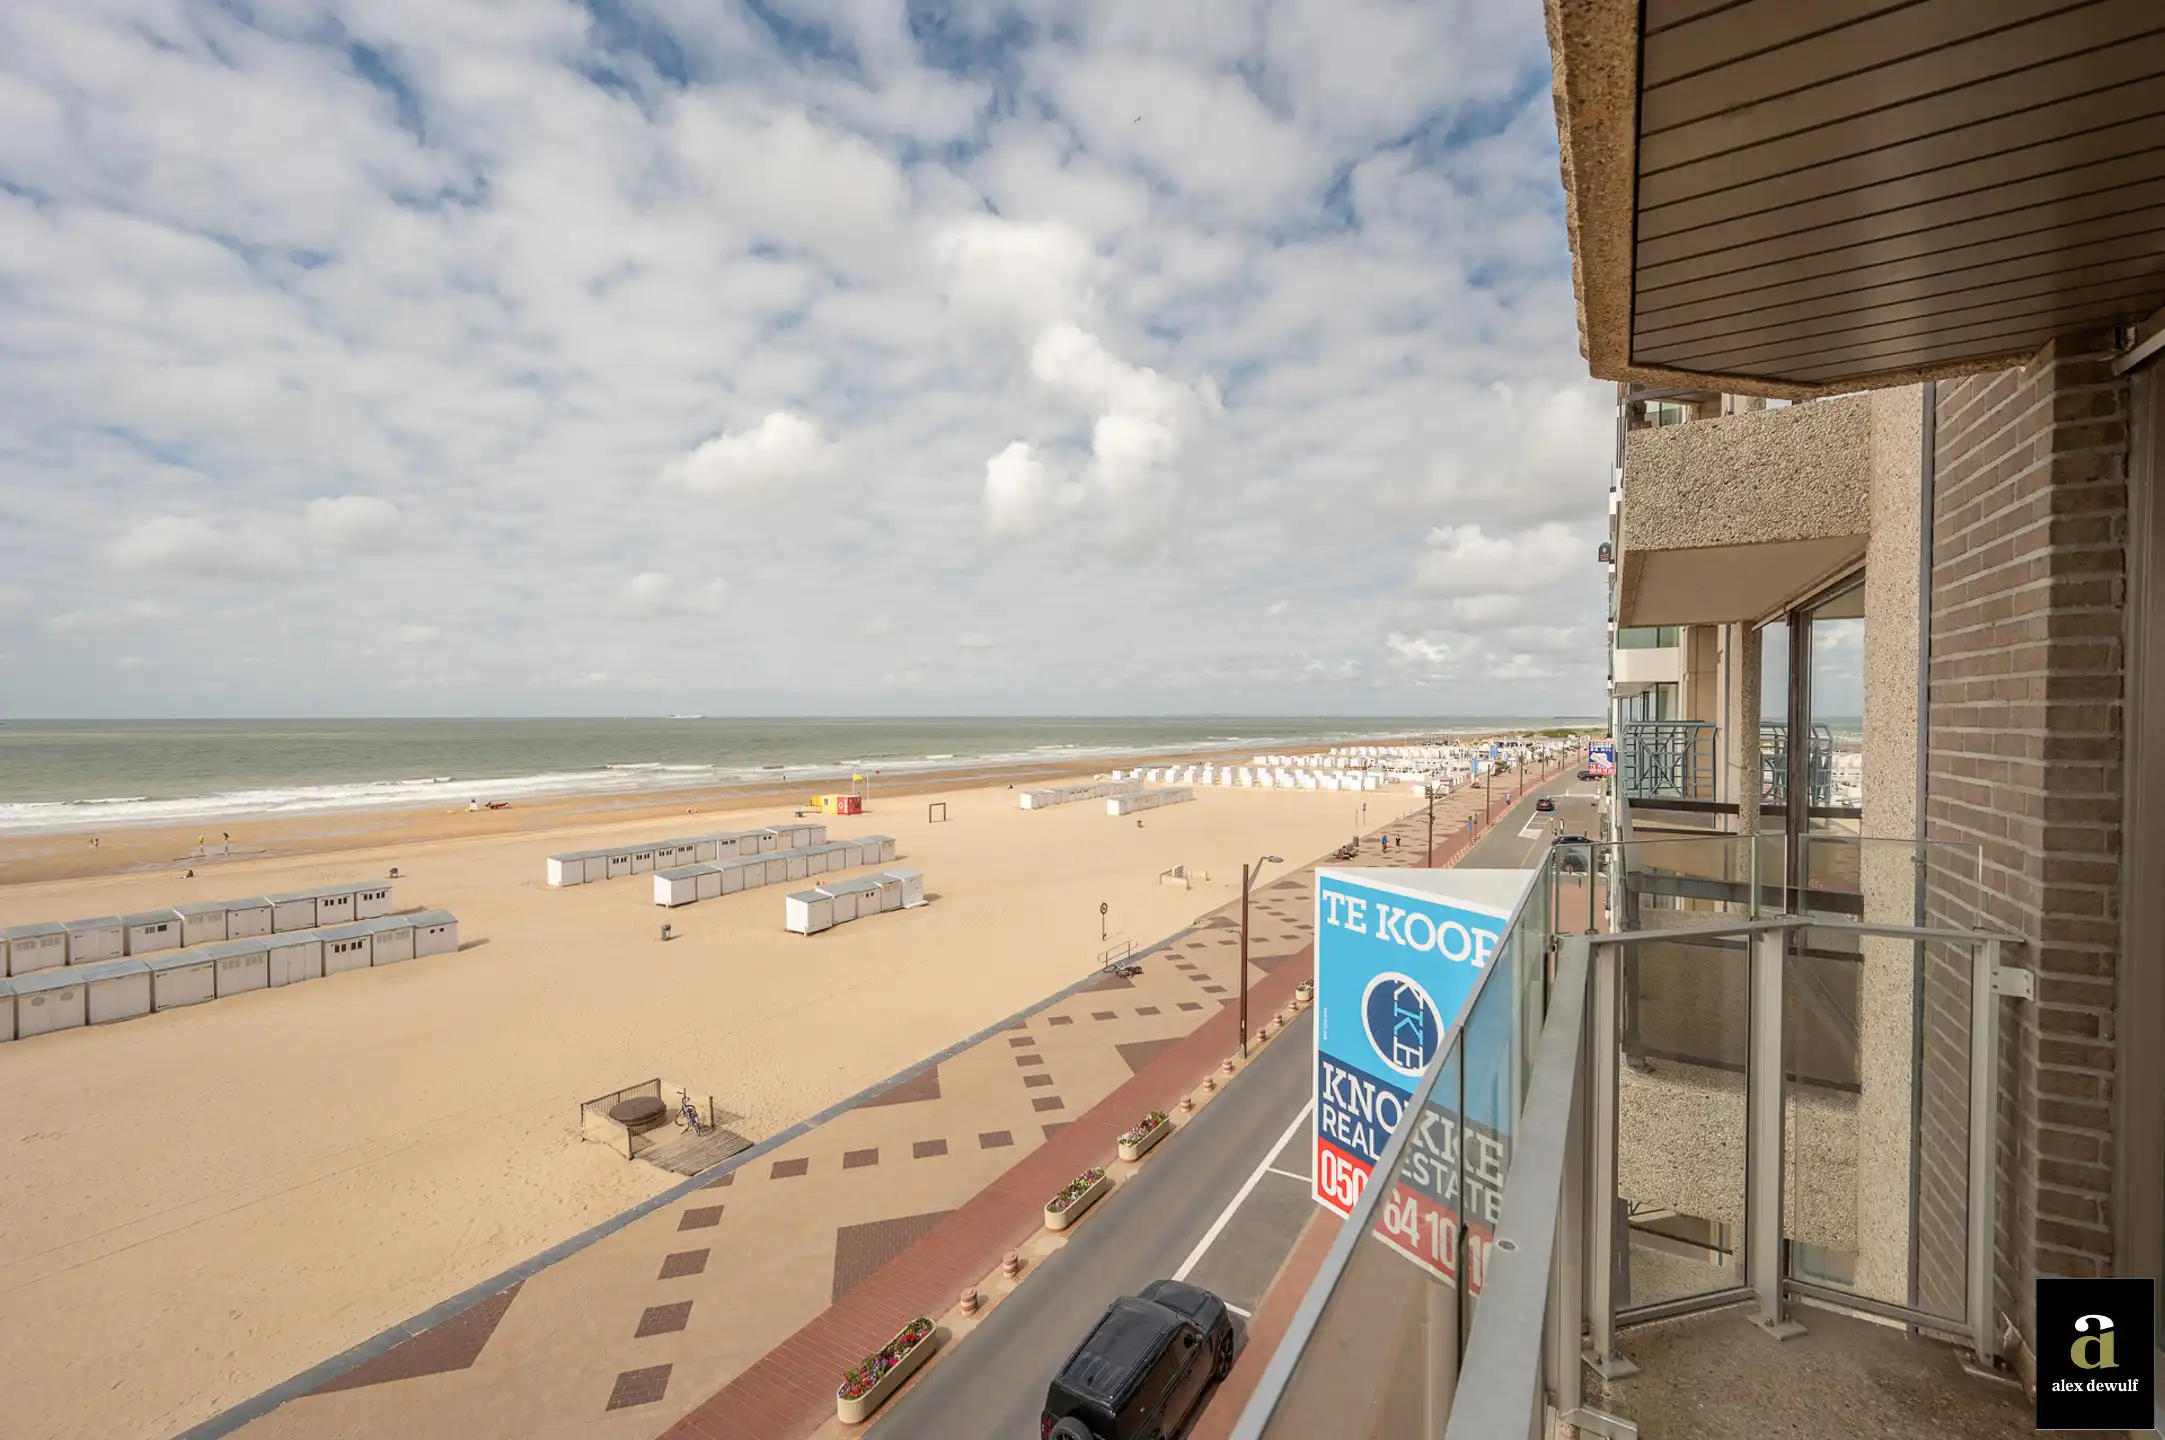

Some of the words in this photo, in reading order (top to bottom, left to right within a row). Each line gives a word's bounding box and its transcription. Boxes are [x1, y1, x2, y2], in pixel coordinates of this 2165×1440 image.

[1322, 889, 1367, 934] TE
[1375, 903, 1499, 968] KOOP
[1323, 1103, 1381, 1161] REAL
[1383, 1187, 1420, 1248] 64
[1425, 1211, 1459, 1271] 10
